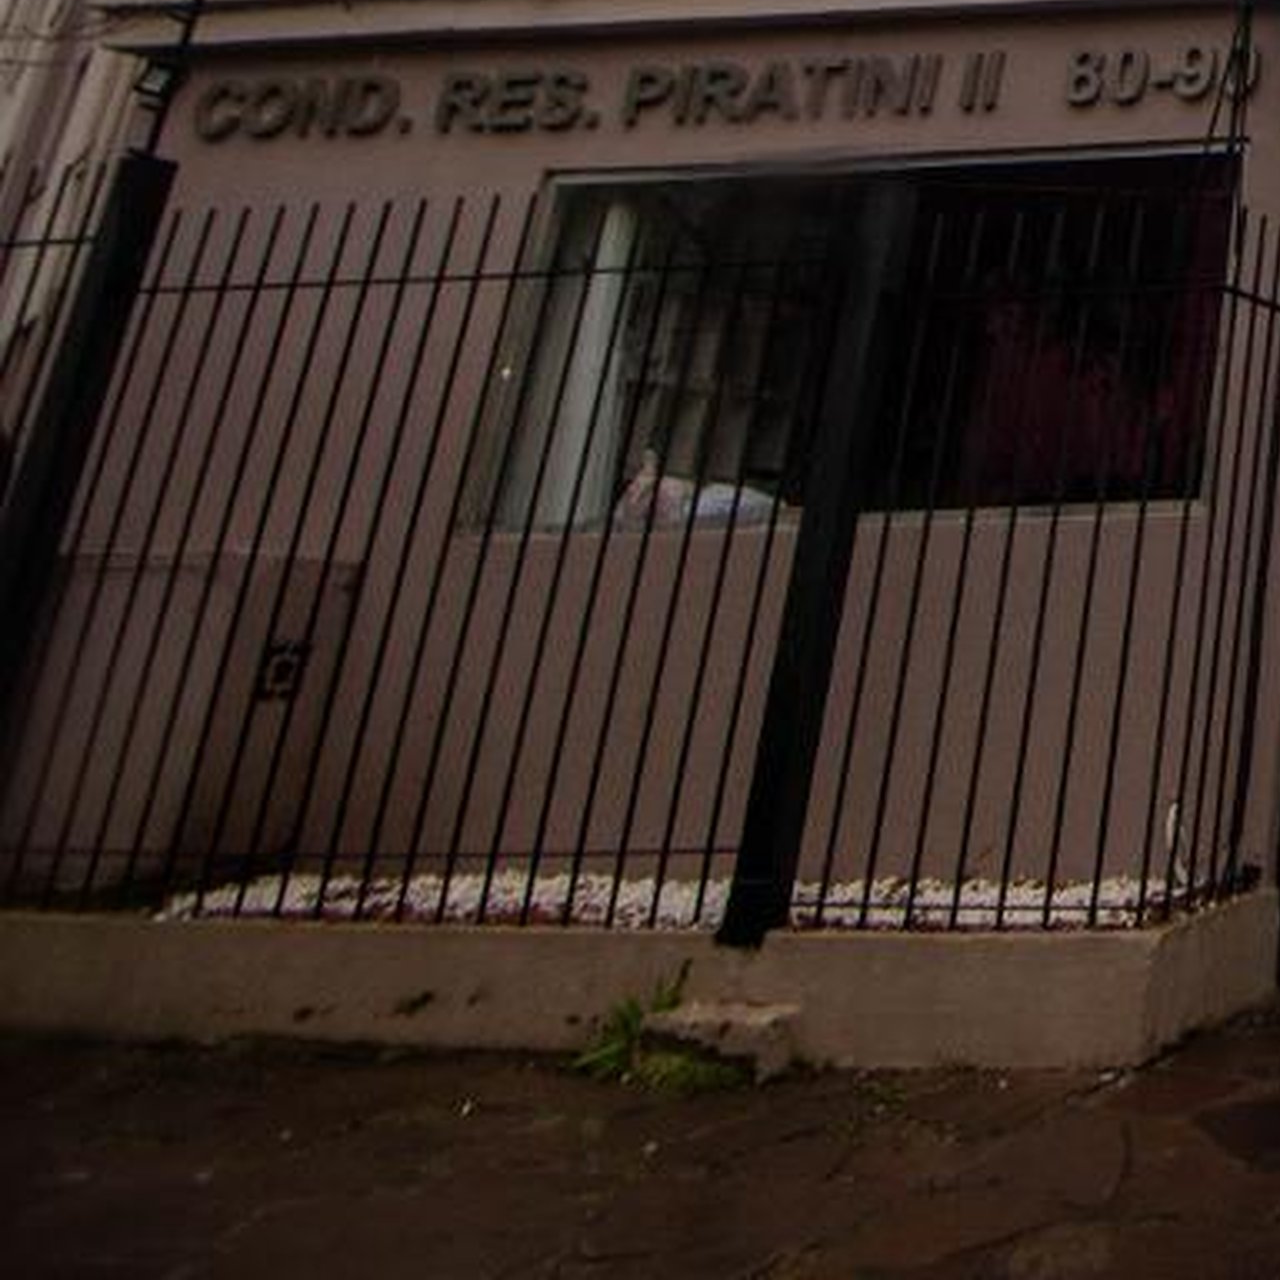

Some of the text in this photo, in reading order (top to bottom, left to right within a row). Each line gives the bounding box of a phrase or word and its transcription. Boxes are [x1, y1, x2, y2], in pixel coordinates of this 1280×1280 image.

[193, 73, 412, 144] COND.
[433, 68, 601, 134] RES.
[620, 51, 943, 130] PIRATINI
[957, 49, 1008, 115] II
